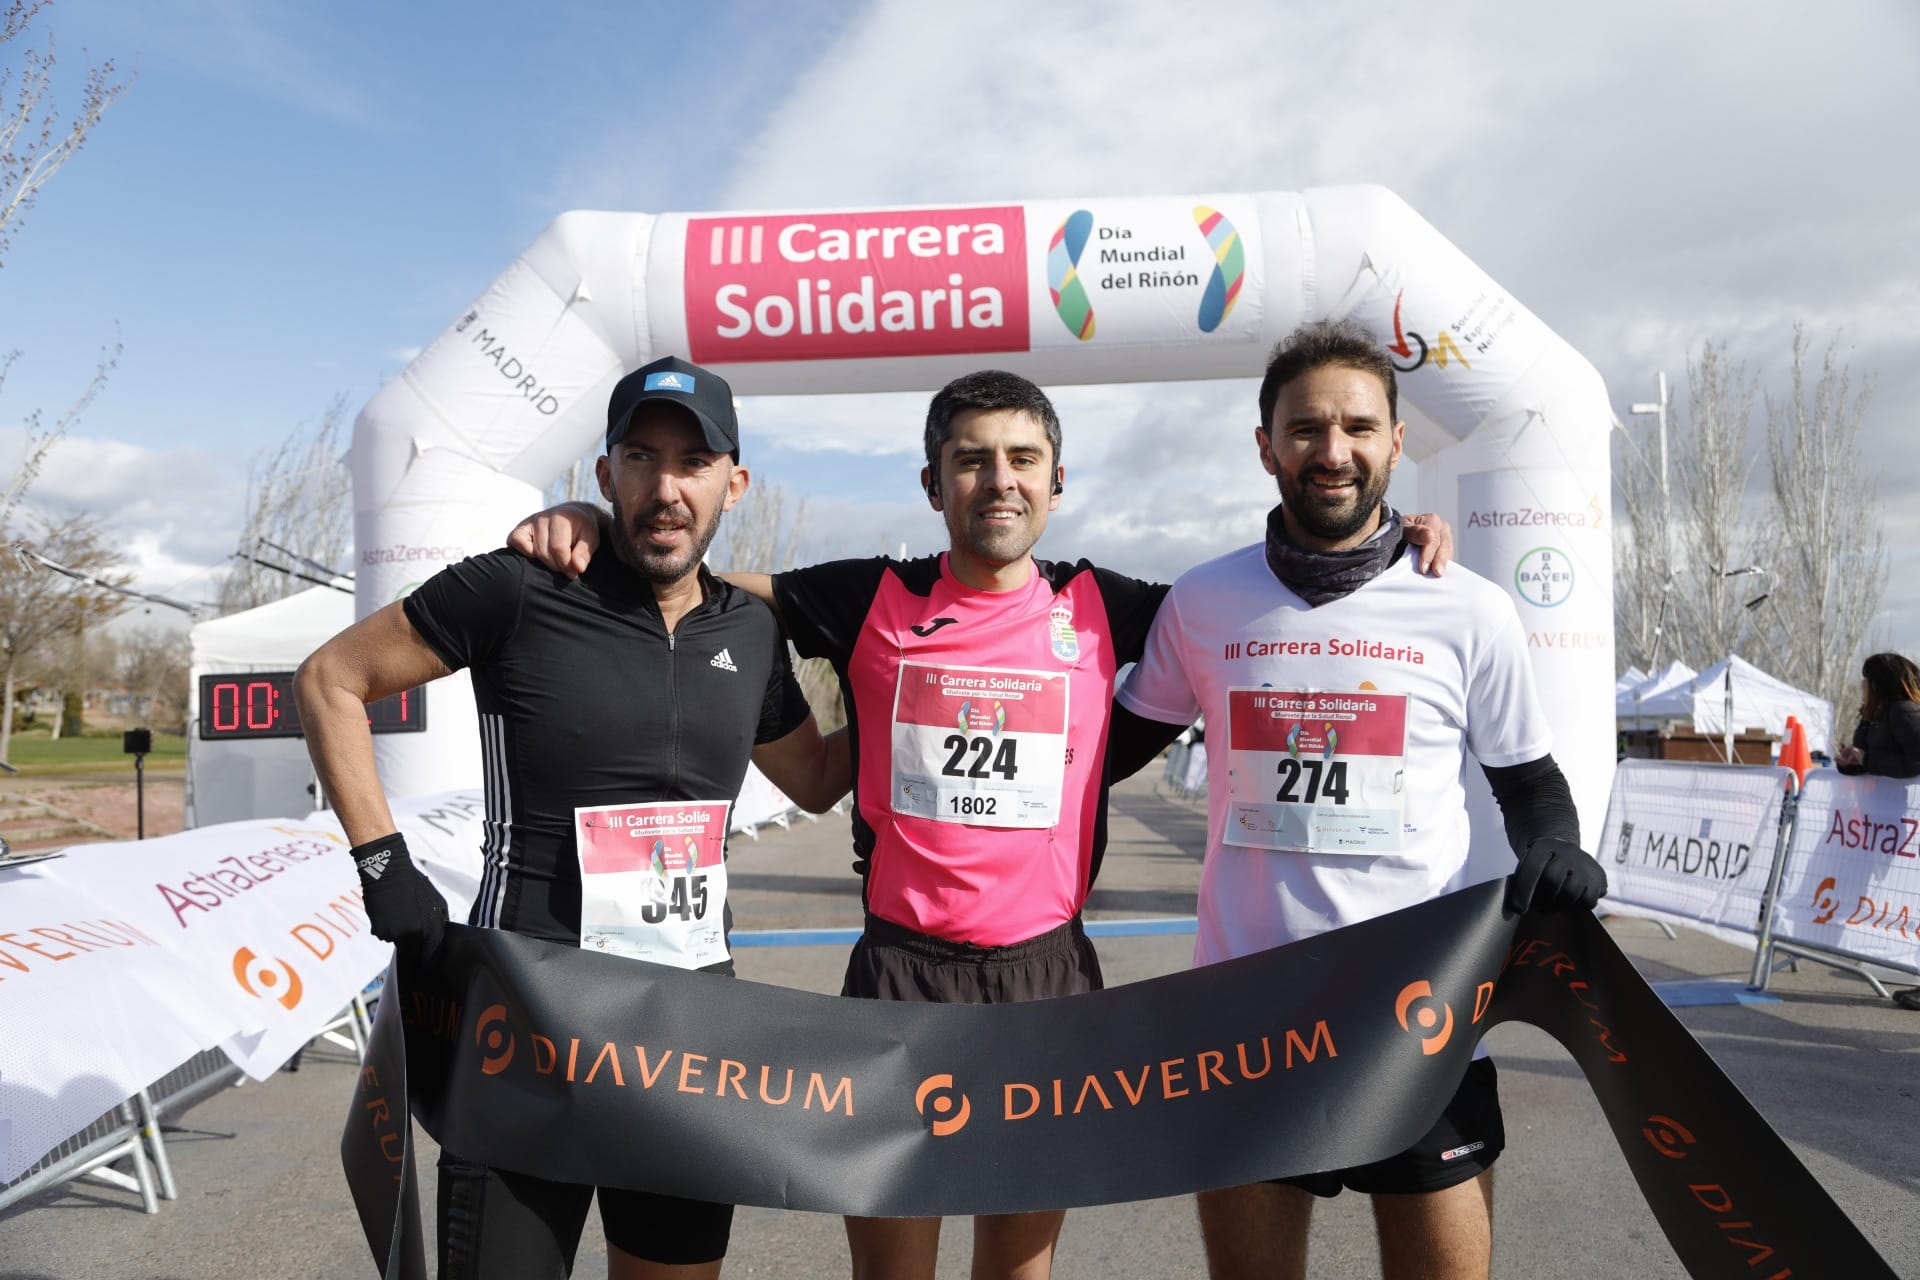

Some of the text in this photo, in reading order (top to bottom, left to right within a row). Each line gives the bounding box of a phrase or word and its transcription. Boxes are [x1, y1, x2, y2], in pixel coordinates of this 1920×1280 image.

[710, 222, 1005, 266] III Carrera
[1098, 226, 1133, 241] Día
[1099, 246, 1186, 264] Mundial
[1100, 268, 1200, 290] del Riñón
[715, 274, 1005, 340] Solidaria
[472, 328, 559, 416] MADRID
[1466, 508, 1586, 529] AstraZeneca
[361, 544, 465, 566] AstraZeneca
[1520, 572, 1570, 582] BAYER
[1542, 551, 1552, 603] BAYER
[1225, 638, 1424, 665] III Carrera Solidaria
[926, 673, 1043, 692] III Carrera Solidaria
[1254, 697, 1377, 712] III Carrera Solidaria
[942, 734, 1018, 781] 224
[1277, 758, 1349, 806] 274
[608, 816, 623, 829] III
[626, 814, 674, 827] Carrera
[950, 796, 997, 815] 1802
[1643, 830, 1750, 881] MADRID
[1826, 809, 1920, 859] AstraZ
[156, 840, 335, 929] AstraZeneca
[640, 874, 708, 925] 345
[530, 1032, 856, 1117] DIAVERUM
[1003, 1019, 1339, 1121] DIAVERUM
